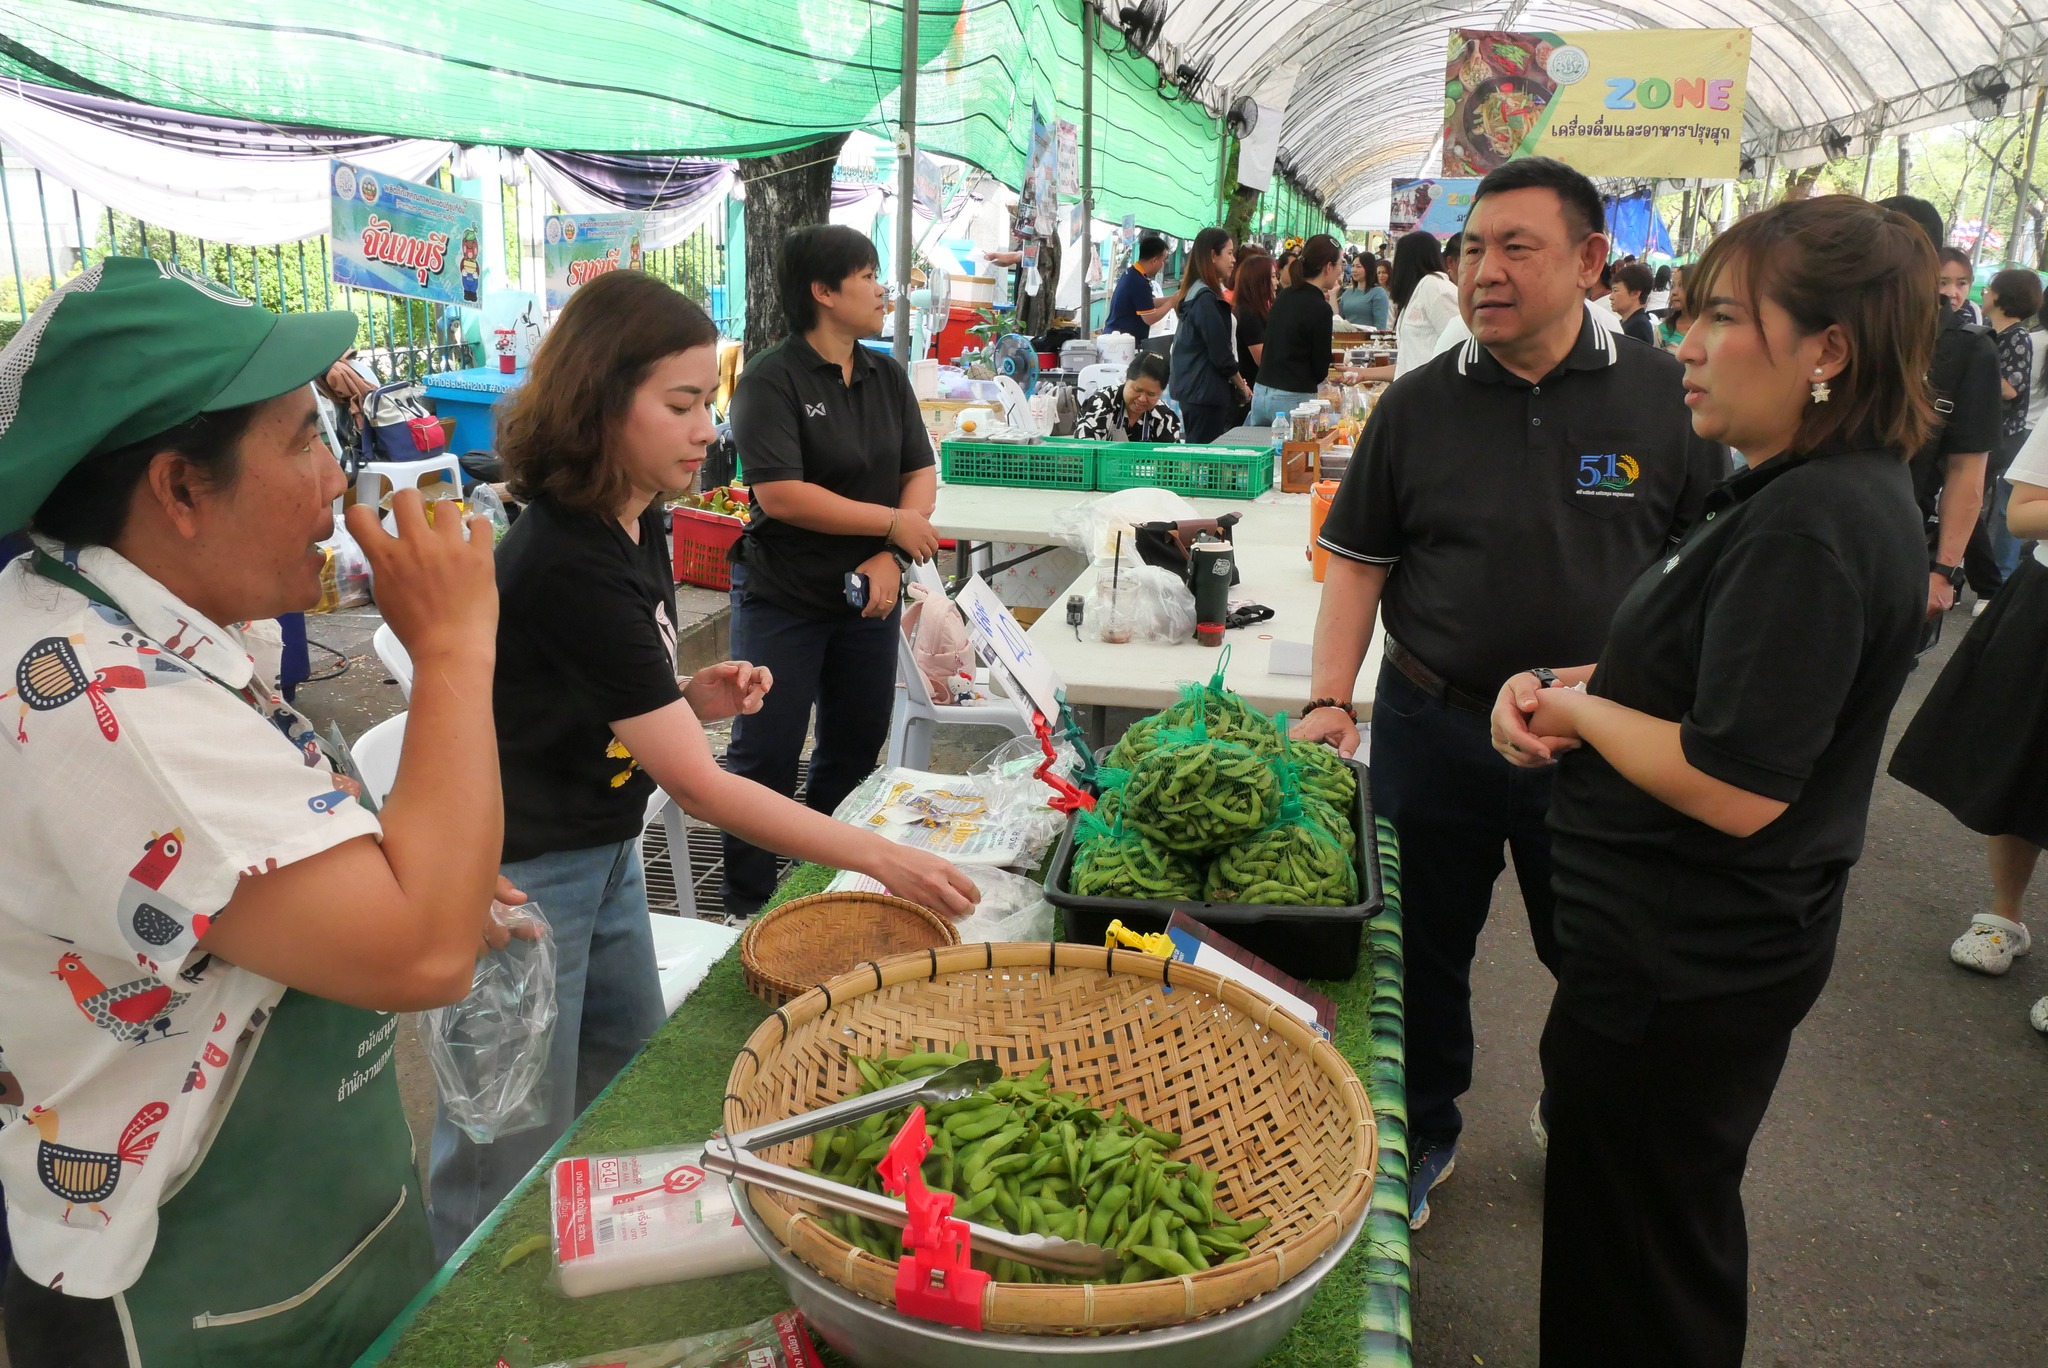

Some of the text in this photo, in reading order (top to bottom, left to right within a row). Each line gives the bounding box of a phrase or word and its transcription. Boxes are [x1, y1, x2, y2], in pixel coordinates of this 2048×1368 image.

[1603, 77, 1734, 111] ZONE
[1551, 114, 1730, 146] เครื่องดื่มและอาหารปรุงสุก
[361, 214, 448, 287] จันทบุรี
[1577, 454, 1619, 487] 51
